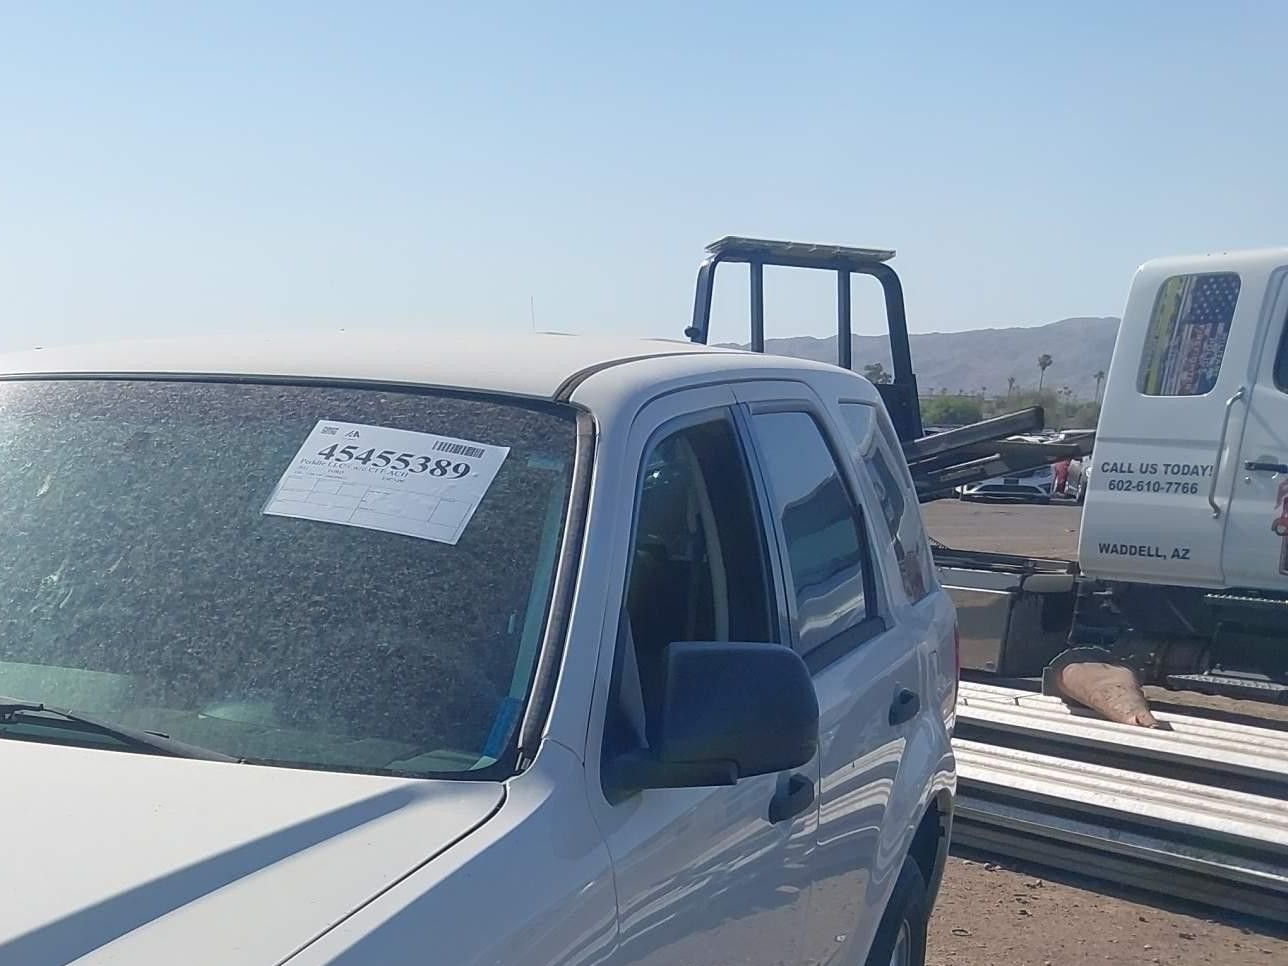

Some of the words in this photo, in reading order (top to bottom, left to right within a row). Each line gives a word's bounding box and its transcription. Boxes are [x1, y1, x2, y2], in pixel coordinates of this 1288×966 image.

[318, 443, 472, 480] 45455389
[1101, 462, 1134, 474] CALL
[1139, 463, 1158, 475] US
[1163, 463, 1214, 477] TODAY!
[1108, 480, 1199, 494] 602-610-7766
[1098, 543, 1167, 560] WADDELL,
[1171, 548, 1191, 560] AZ
